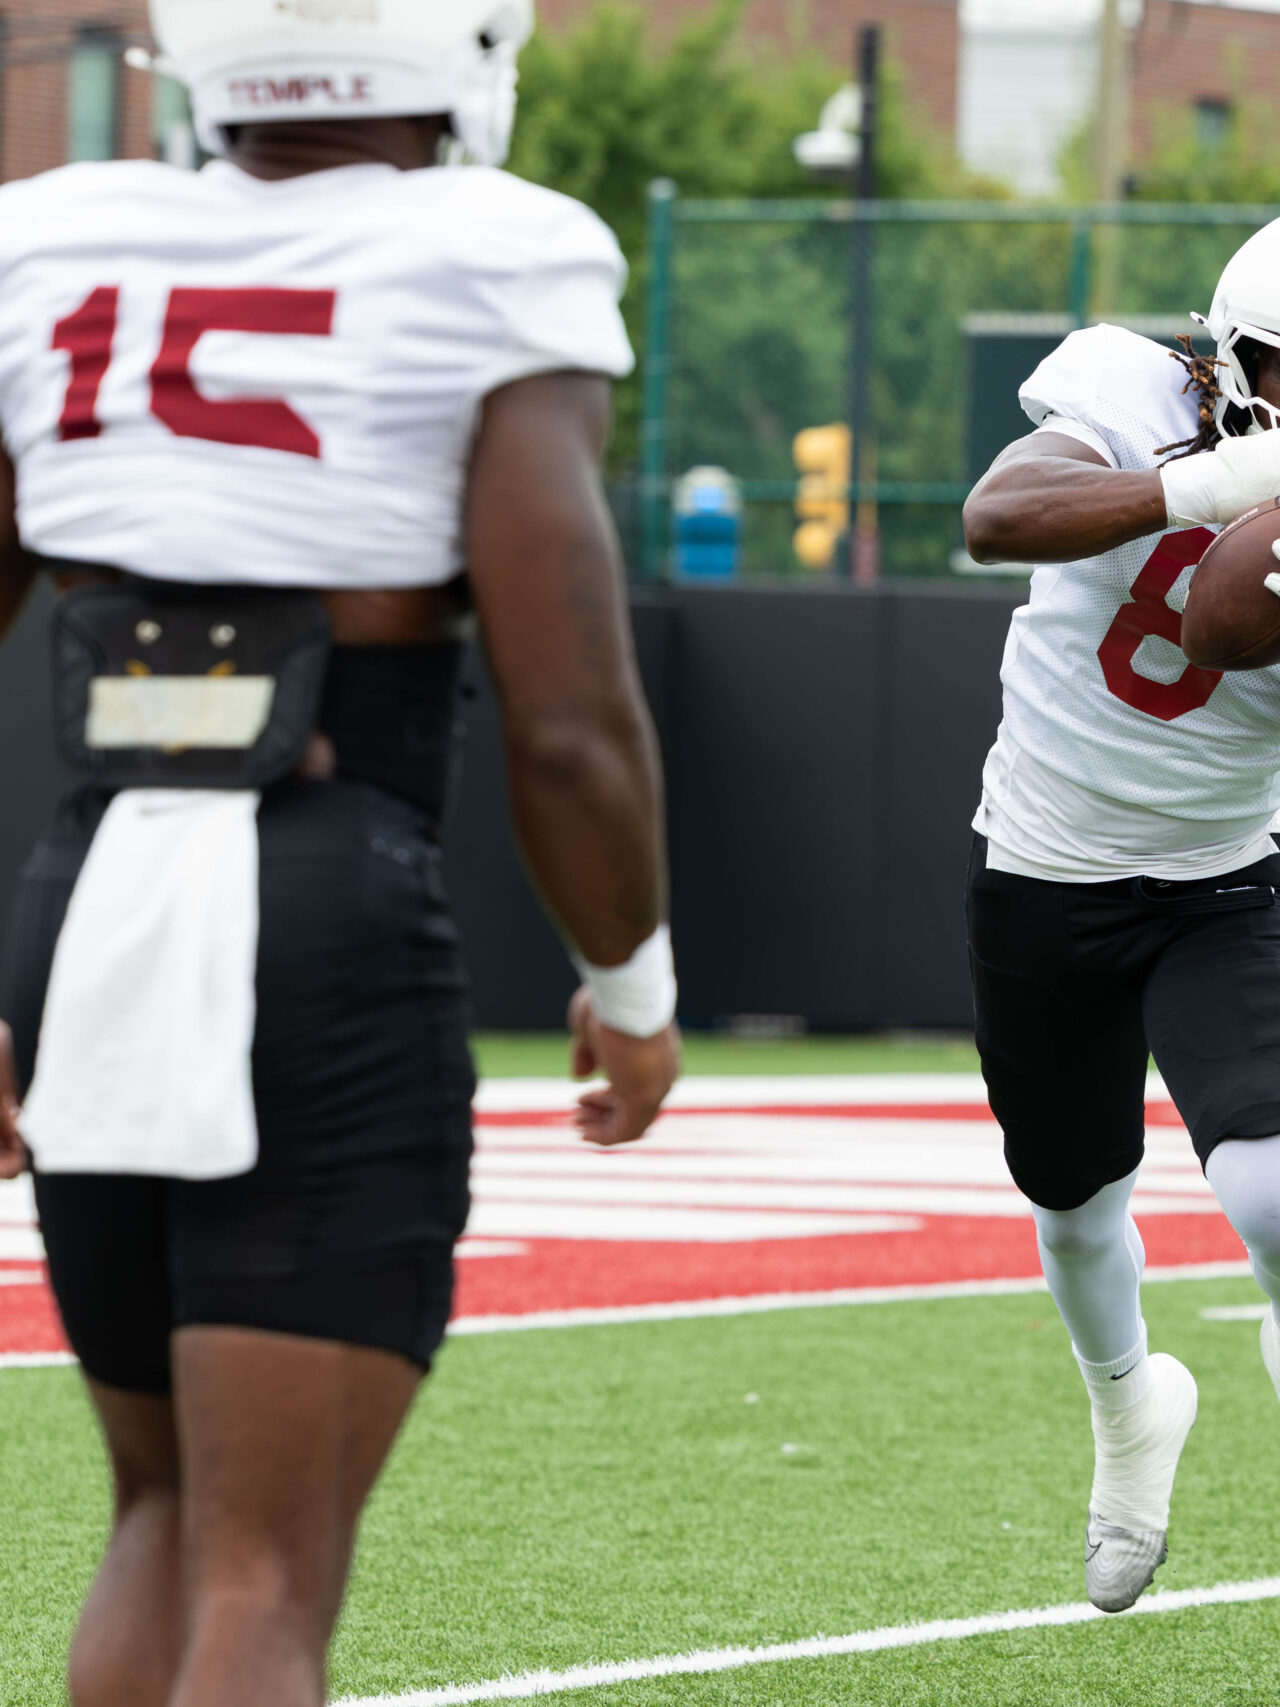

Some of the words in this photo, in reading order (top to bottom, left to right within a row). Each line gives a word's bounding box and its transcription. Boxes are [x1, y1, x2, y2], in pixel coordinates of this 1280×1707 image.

[228, 74, 371, 106] TEMPLE
[51, 286, 337, 459] 15
[1097, 526, 1225, 721] 8
